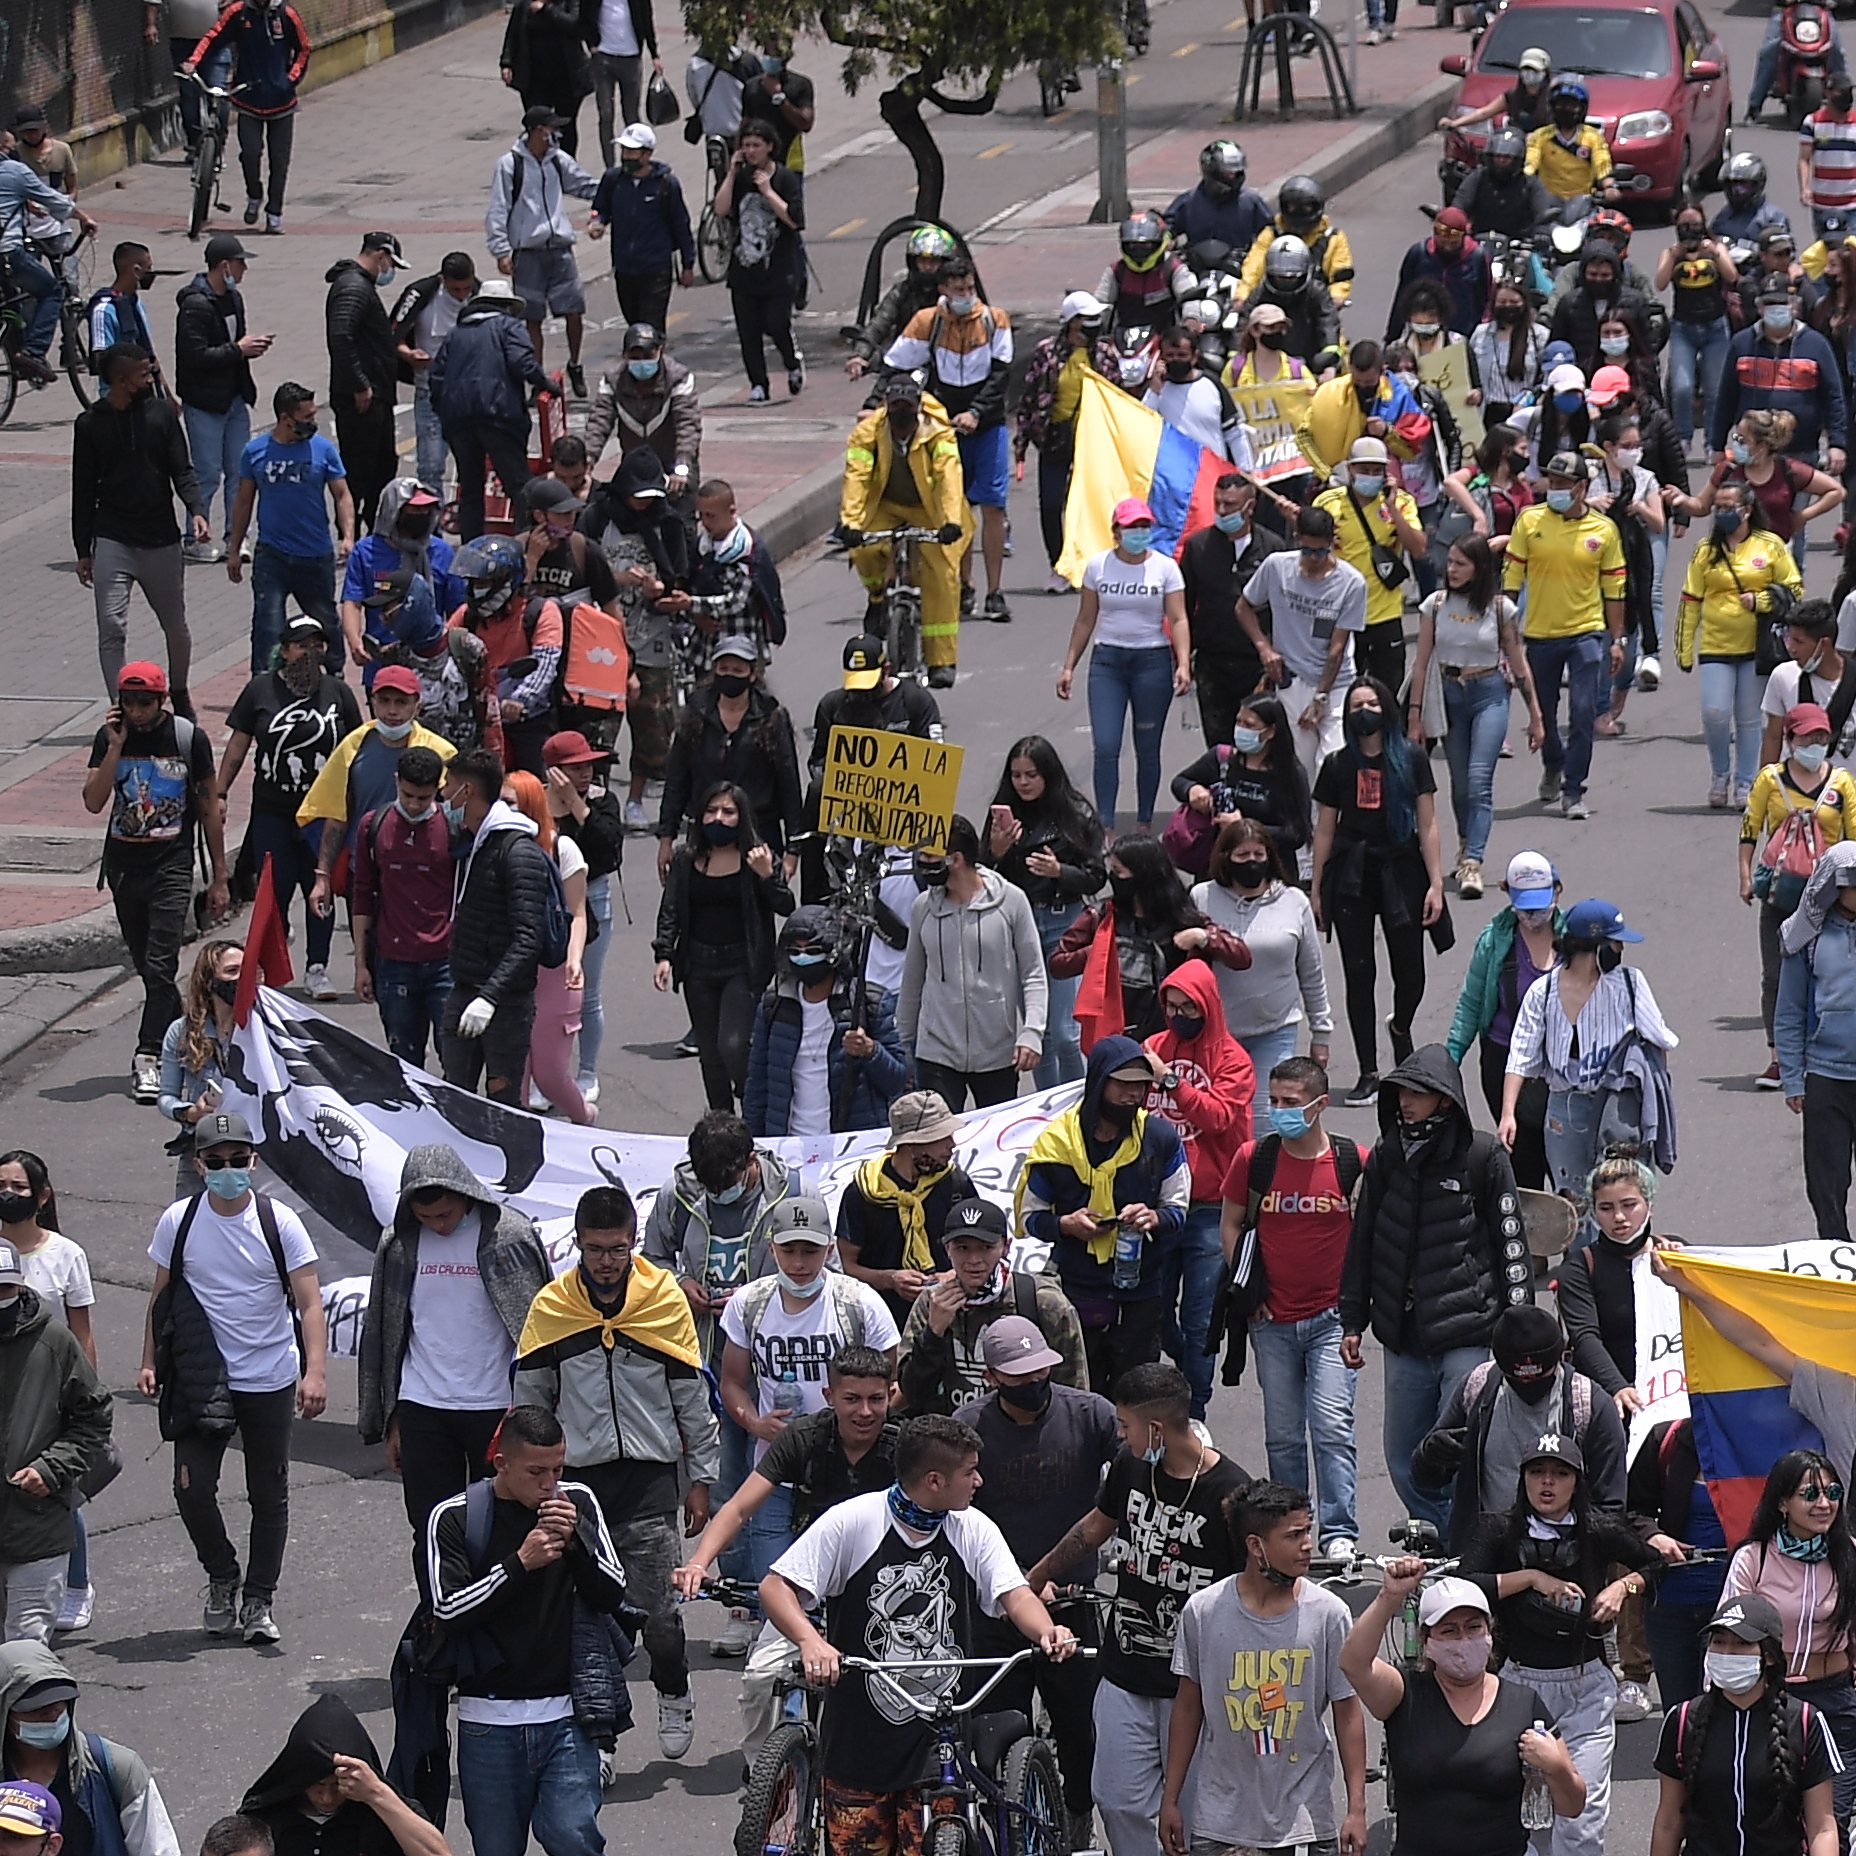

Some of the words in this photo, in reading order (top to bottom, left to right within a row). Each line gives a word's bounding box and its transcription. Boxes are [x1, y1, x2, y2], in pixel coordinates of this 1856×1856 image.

[832, 733, 881, 768] NO
[887, 741, 909, 771] A
[923, 747, 949, 776] LA
[833, 769, 921, 807] REFORMA
[822, 795, 949, 851] TRIBUTARIA
[1260, 1191, 1332, 1215] didas
[420, 1264, 437, 1276] LOS
[951, 1387, 985, 1407] adi
[1127, 1488, 1208, 1550] FUCK
[1131, 1524, 1166, 1556] THE
[1227, 1648, 1312, 1693] JUST
[1223, 1694, 1268, 1733] DO
[1270, 1700, 1305, 1742] IT
